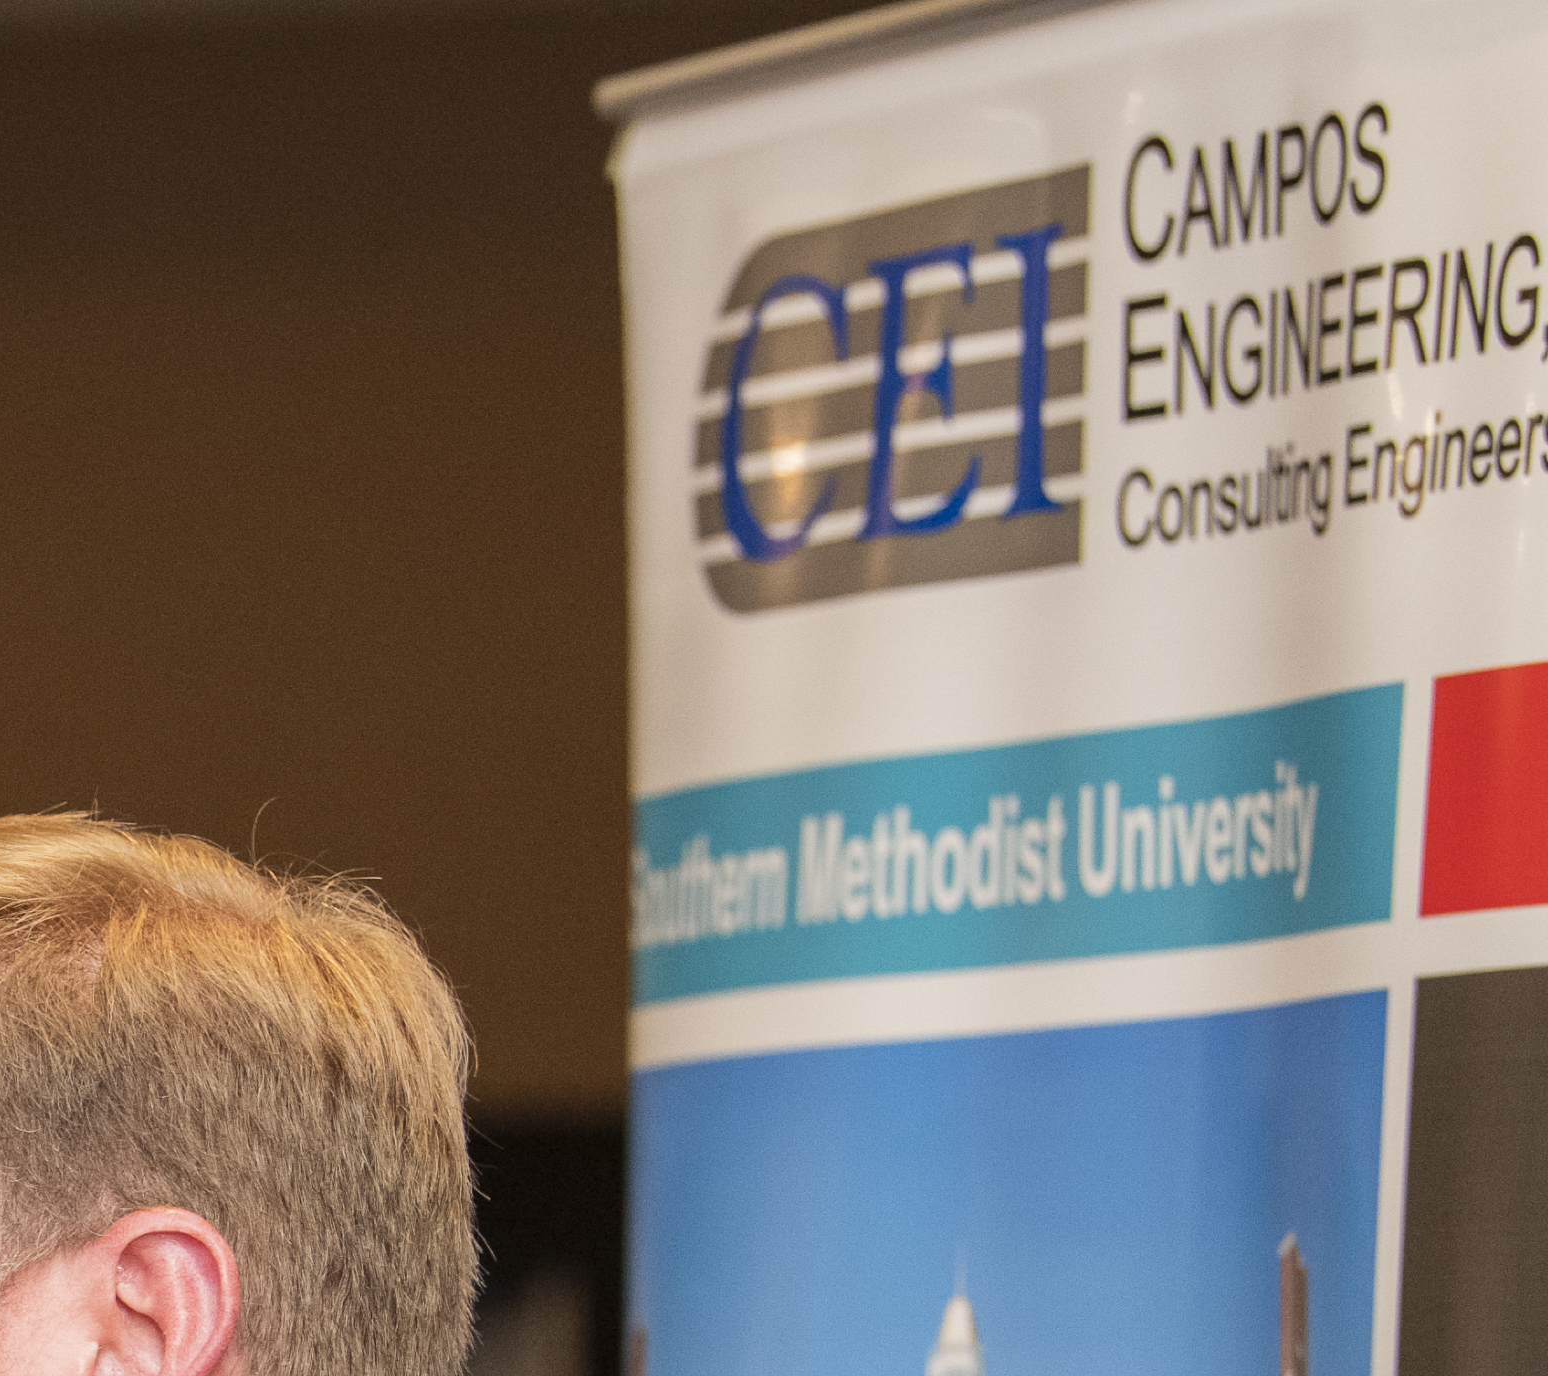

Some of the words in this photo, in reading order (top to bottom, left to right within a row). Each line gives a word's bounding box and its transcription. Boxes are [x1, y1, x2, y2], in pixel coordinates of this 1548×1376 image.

[1120, 100, 1390, 264] CAMPOS
[720, 223, 1063, 563] CEI
[1116, 441, 1334, 548] Consulting
[794, 793, 1067, 926] Methodist
[1077, 760, 1319, 900] University
